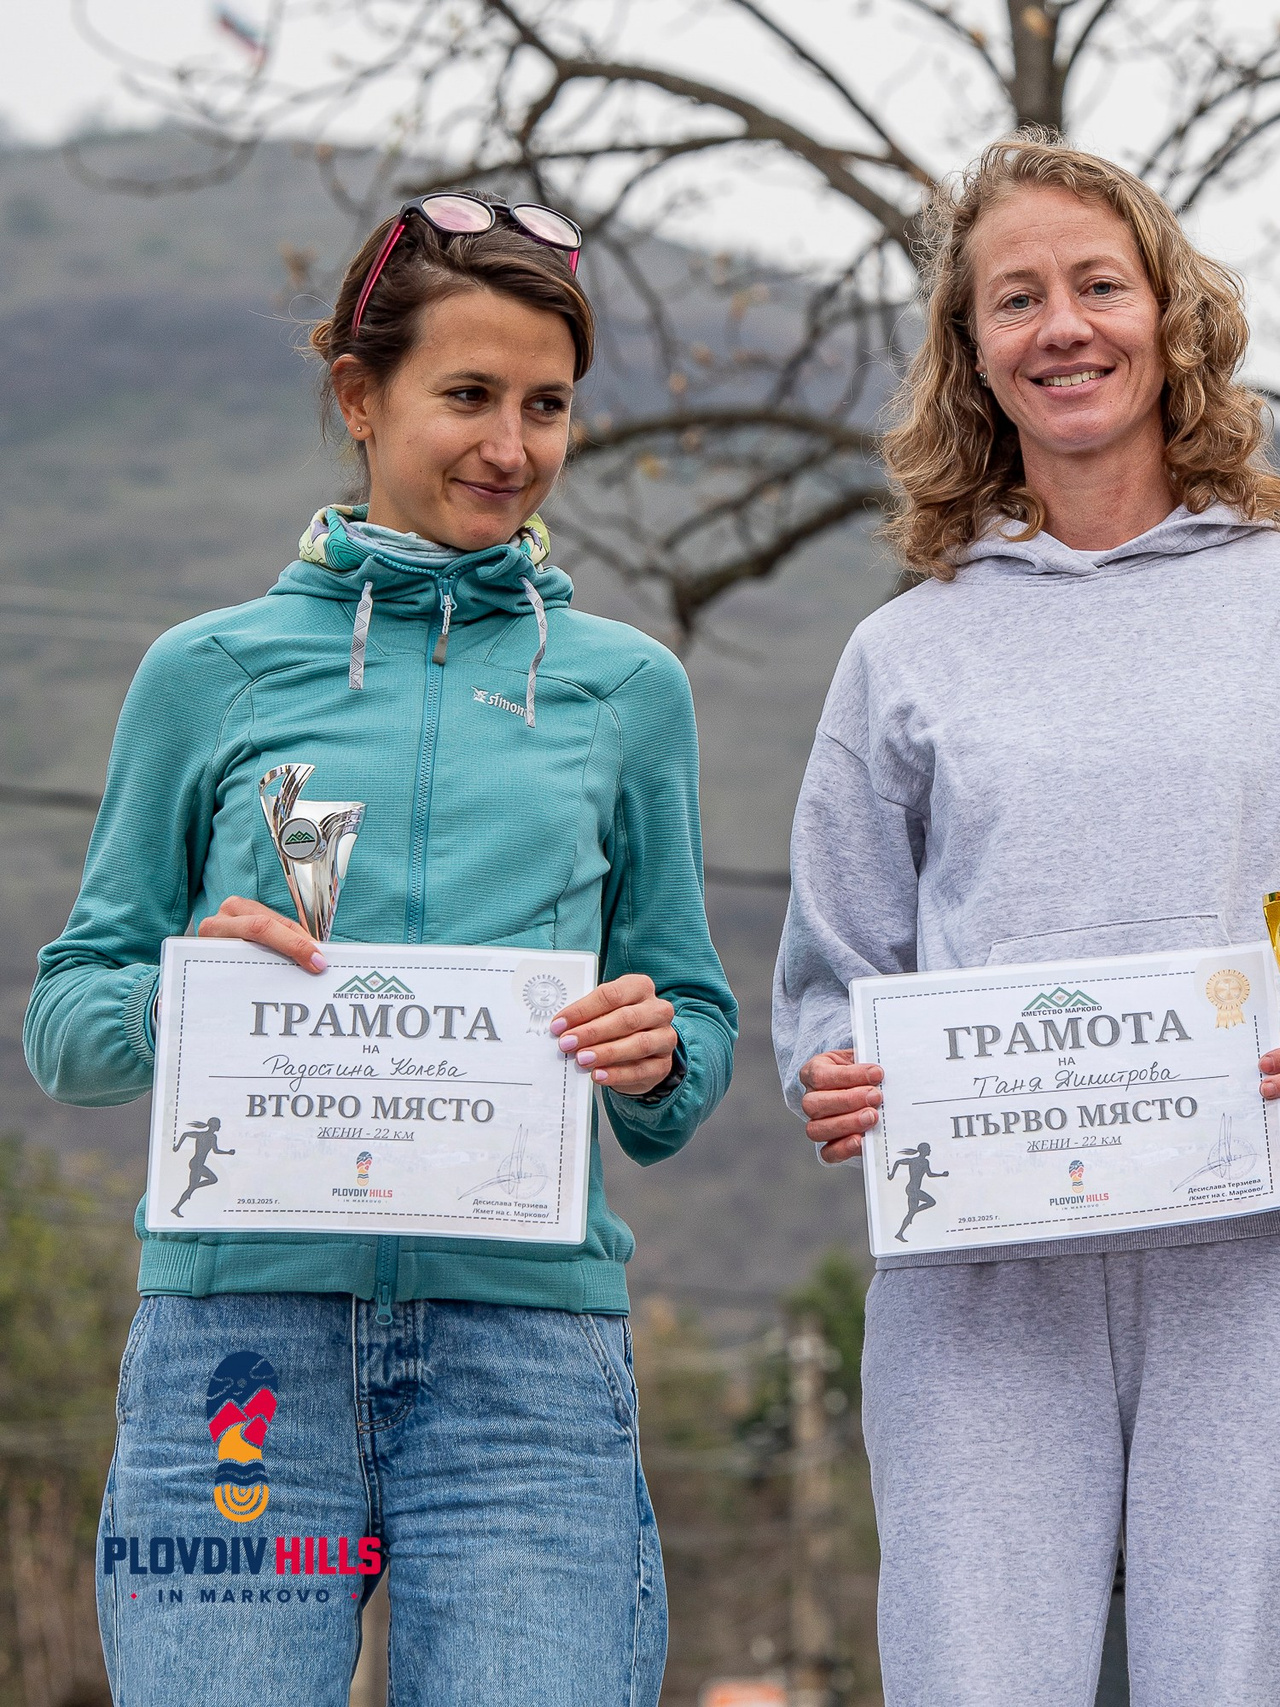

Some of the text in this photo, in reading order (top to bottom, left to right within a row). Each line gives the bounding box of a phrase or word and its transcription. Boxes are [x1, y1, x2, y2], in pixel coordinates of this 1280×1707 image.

[488, 692, 527, 718] simon
[377, 993, 416, 1001] МАРКОВО
[1021, 1005, 1103, 1017] КМЕТСТВО МАРКОВО
[250, 1001, 502, 1042] ГРАМОТА
[943, 1009, 1192, 1061] ГРАМОТА
[362, 1044, 380, 1054] НА
[1058, 1057, 1076, 1067] НА
[263, 1054, 468, 1092] Радостина Колева
[973, 1075, 1043, 1098] Таня
[245, 1094, 494, 1123] ВТОРО МЯСТО
[950, 1095, 1199, 1139] ПЪРВО МЯСТО
[317, 1126, 364, 1139] ЖЕНИ
[374, 1127, 389, 1139] 22
[393, 1130, 415, 1141] км
[1027, 1138, 1071, 1151] ЖЕНИ
[1082, 1136, 1097, 1147] 22
[1101, 1135, 1122, 1146] км
[332, 1188, 393, 1198] PLOVDIV HILLS
[1188, 1178, 1261, 1194] Десислава Терзиева
[1049, 1193, 1109, 1206] PLOVDIV HILLS
